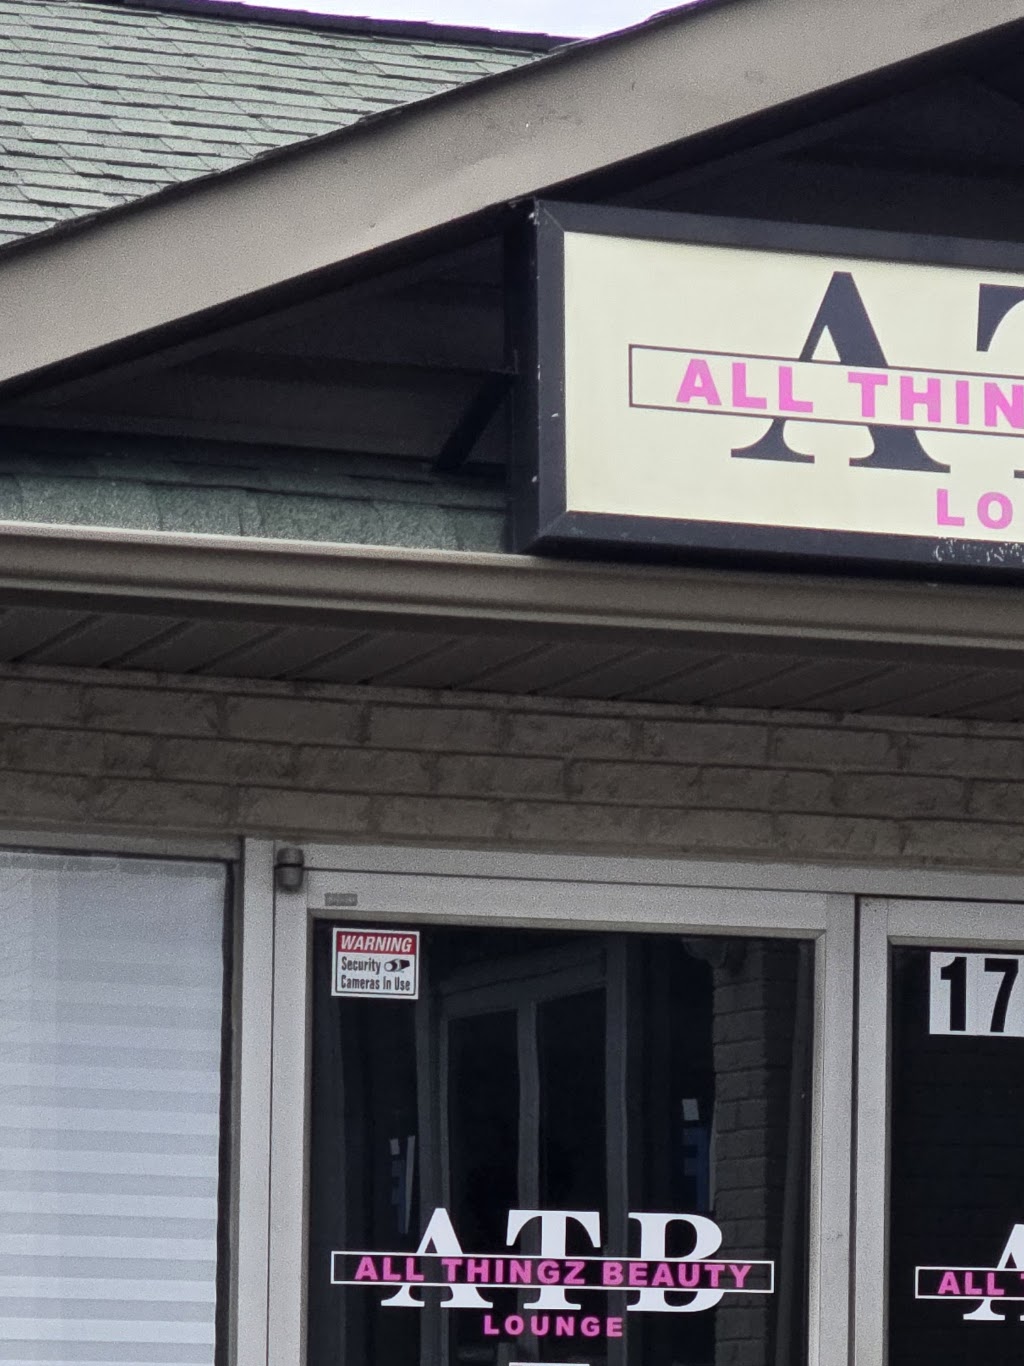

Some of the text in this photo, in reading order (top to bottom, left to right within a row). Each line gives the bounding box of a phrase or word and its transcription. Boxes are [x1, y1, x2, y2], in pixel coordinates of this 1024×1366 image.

[676, 358, 814, 413] ALL
[340, 935, 413, 953] WARNING
[341, 956, 381, 975] Security
[341, 975, 411, 991] Cameras In Use
[380, 1207, 724, 1313] ATB
[354, 1256, 752, 1289] ALL THINGZ BEAUTY
[937, 1271, 1005, 1296] ALL
[483, 1315, 624, 1337] LOUNGE
